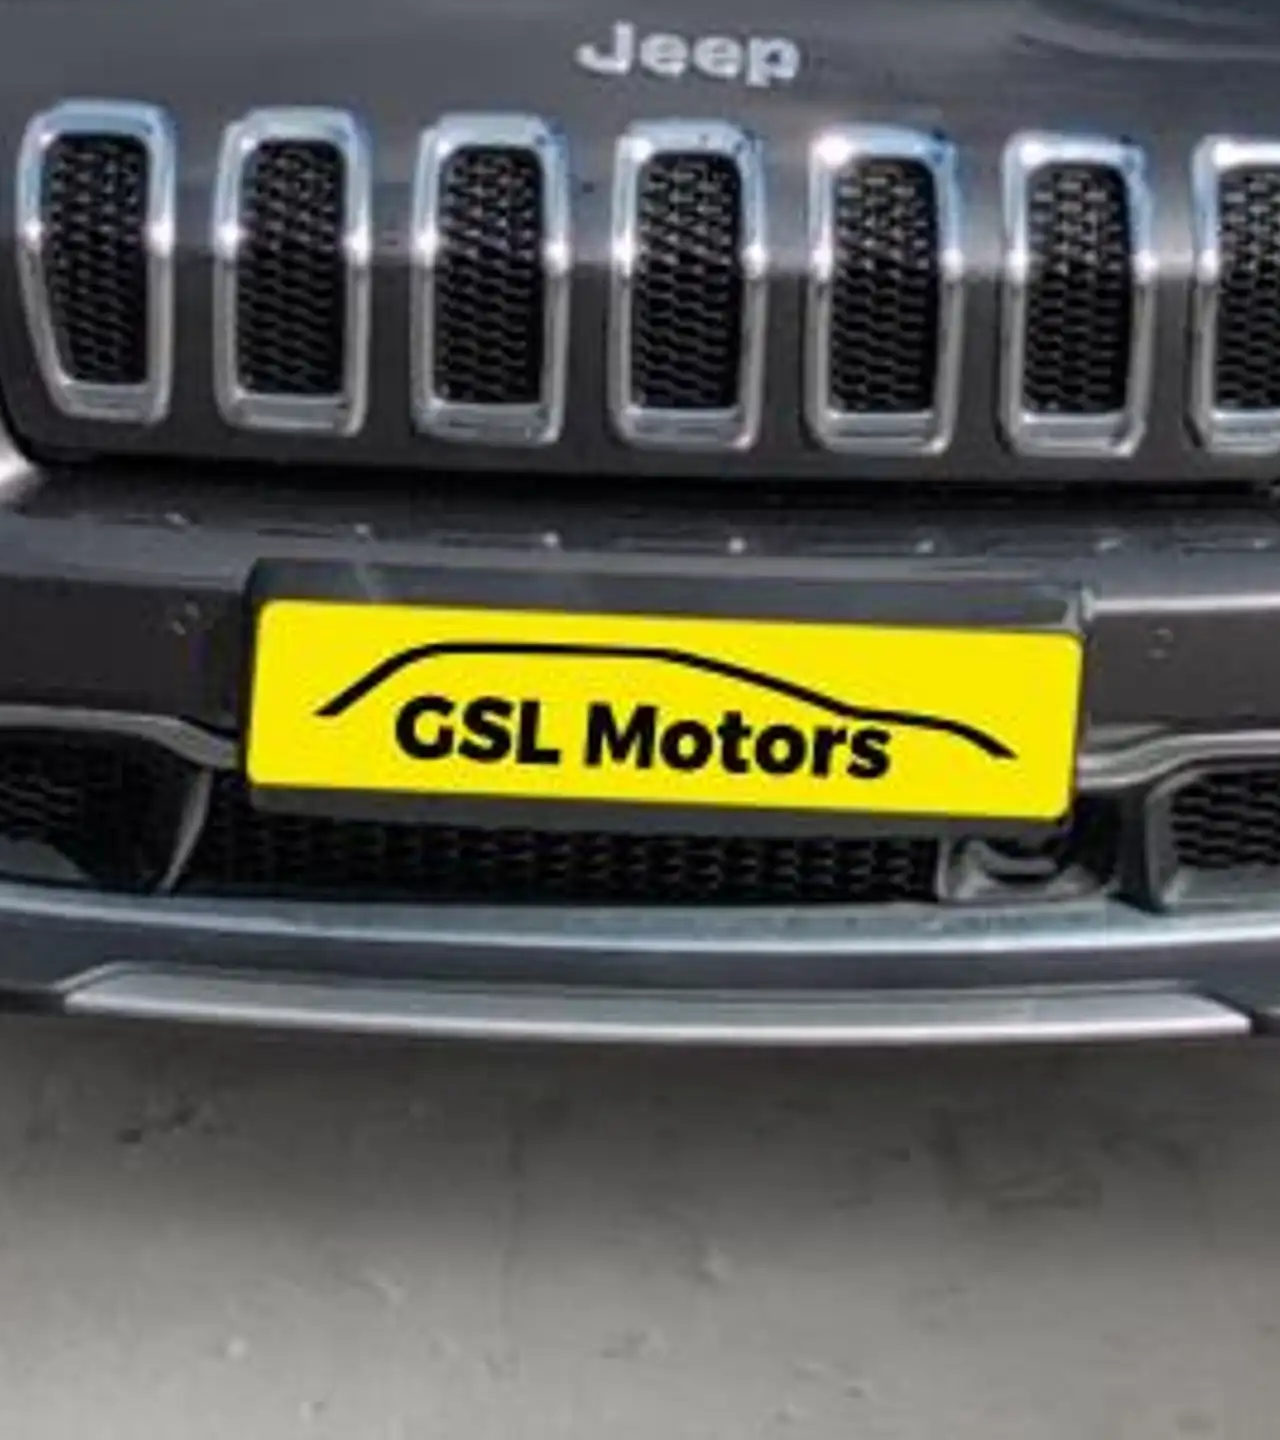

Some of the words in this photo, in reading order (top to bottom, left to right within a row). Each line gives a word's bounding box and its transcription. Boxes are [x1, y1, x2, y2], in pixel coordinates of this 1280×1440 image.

[574, 17, 801, 87] Jeep
[394, 695, 561, 762] GSL
[585, 703, 891, 778] Motors
